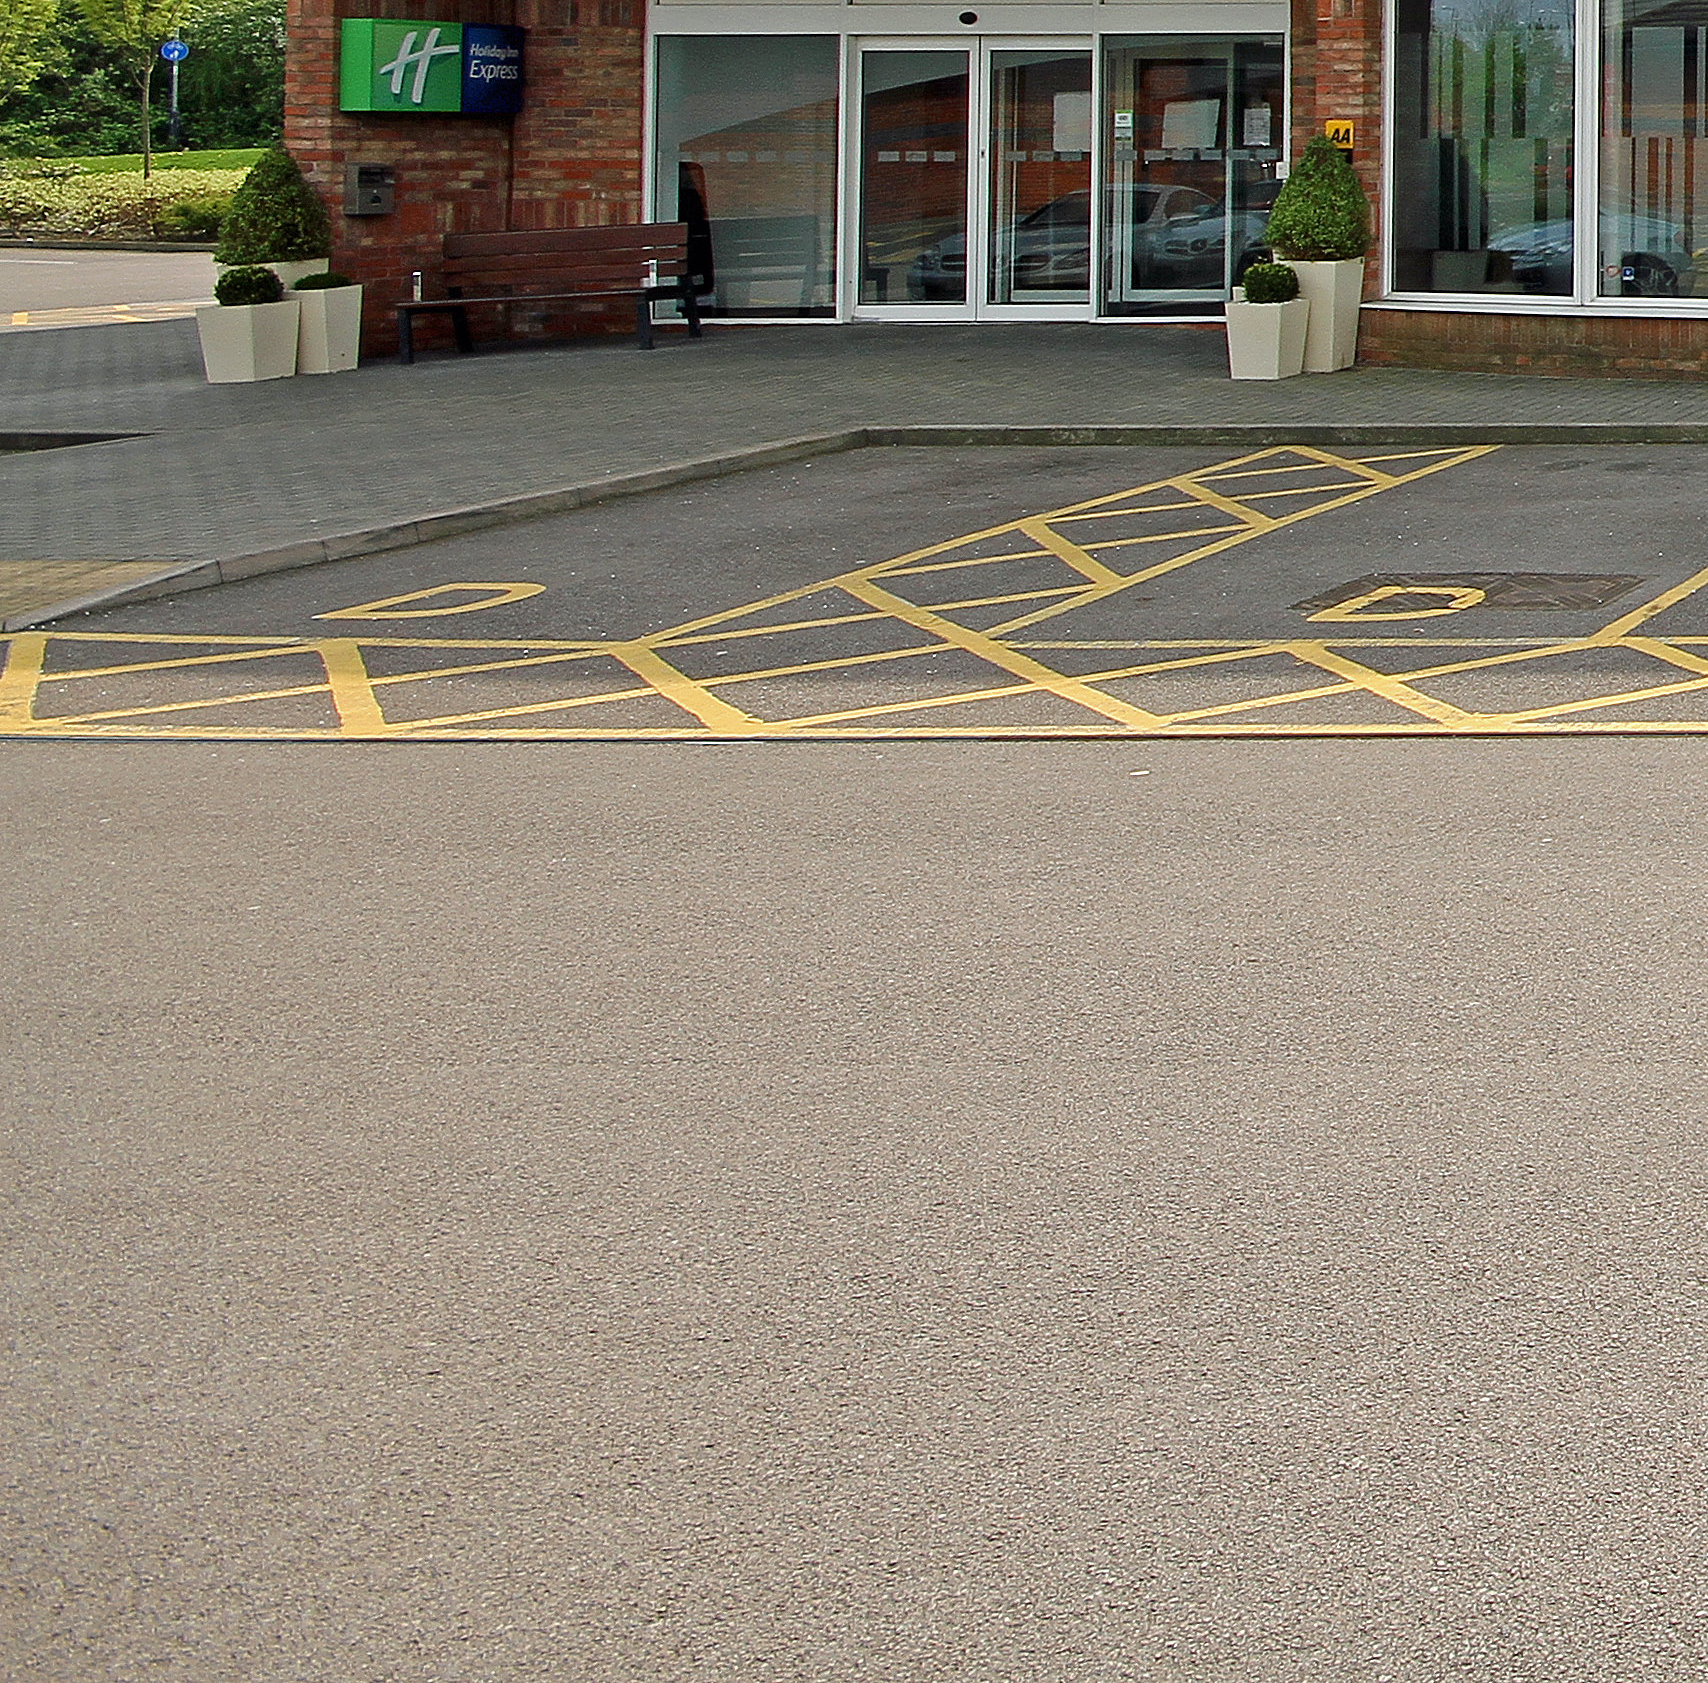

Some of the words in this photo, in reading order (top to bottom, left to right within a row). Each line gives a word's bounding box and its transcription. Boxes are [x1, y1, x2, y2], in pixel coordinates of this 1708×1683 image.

[470, 43, 506, 60] Holiday
[470, 60, 518, 83] Express
[1331, 128, 1350, 144] AA
